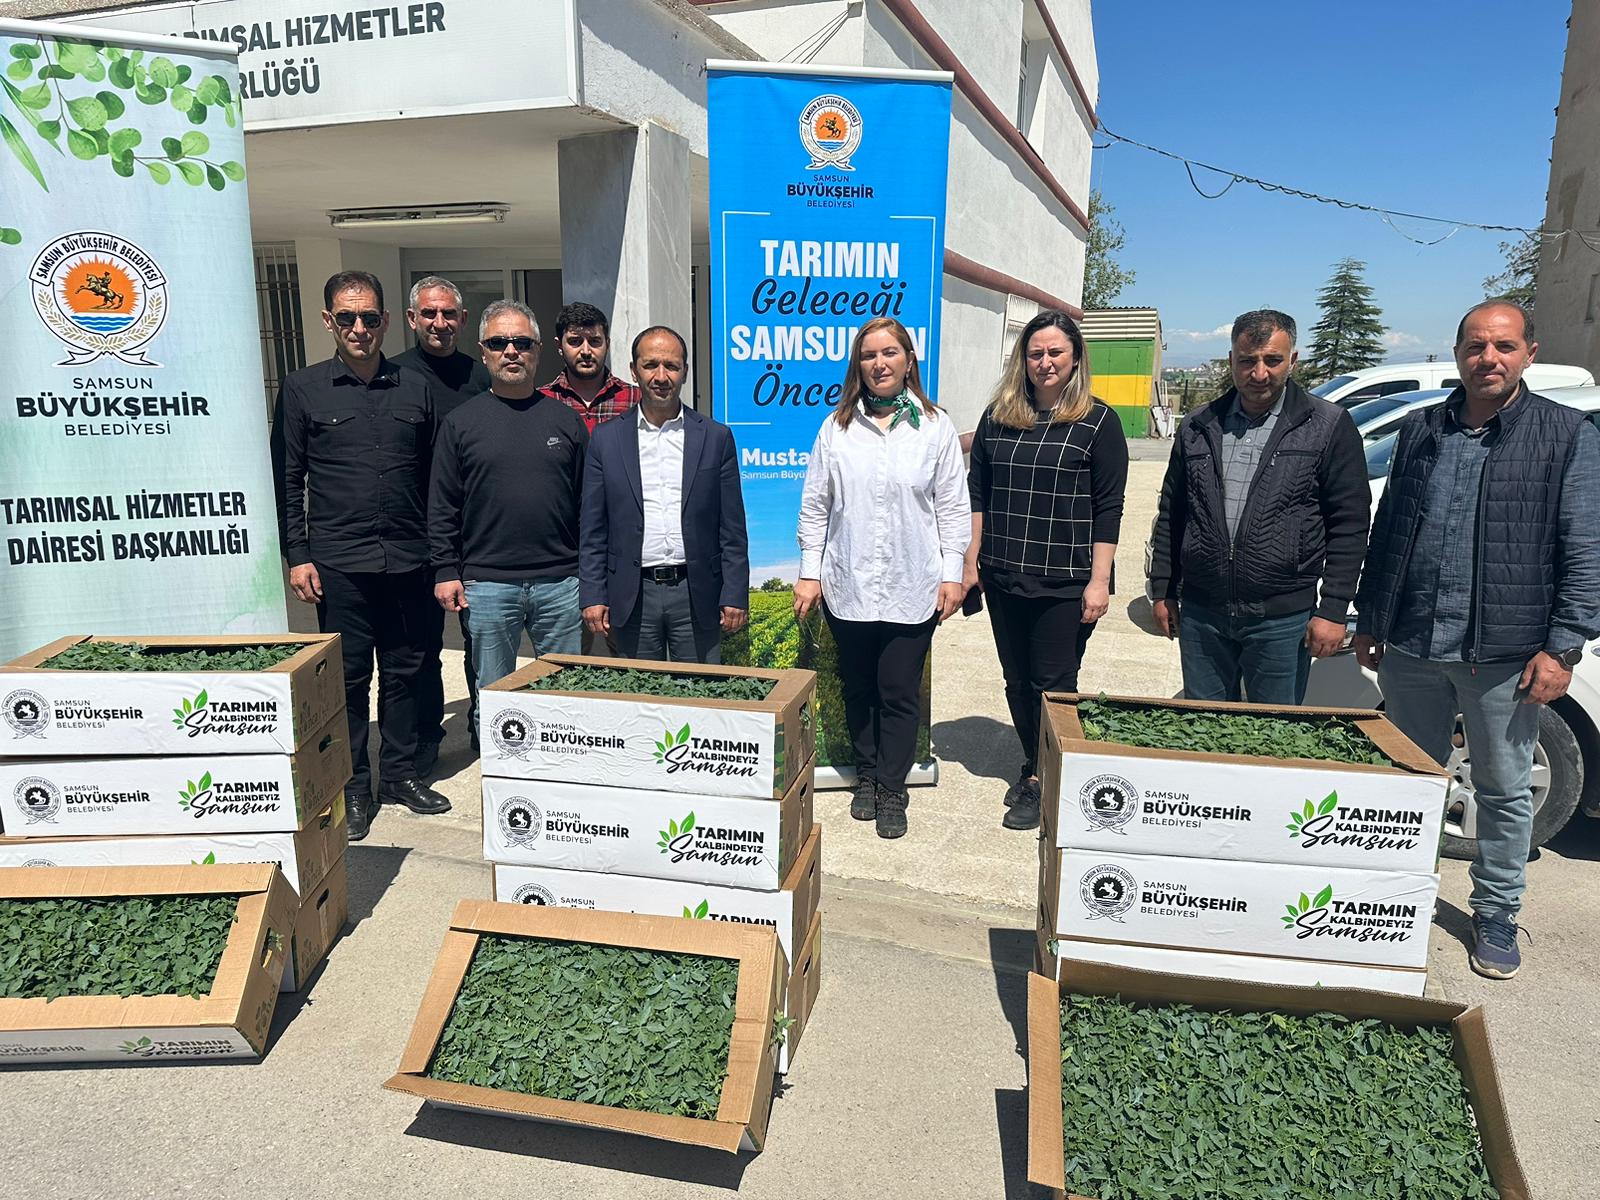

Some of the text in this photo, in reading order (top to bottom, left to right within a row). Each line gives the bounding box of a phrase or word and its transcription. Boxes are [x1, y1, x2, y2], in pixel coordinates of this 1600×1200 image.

[813, 174, 850, 182] SAMSUN
[787, 182, 874, 199] BÜYÜKŞEHİR
[807, 199, 855, 208] BELEDİYESİ
[36, 234, 162, 283] SAMSUN BÜYÜKŞEHİR BELEDİYESİ
[760, 239, 900, 278] TARIMIN
[751, 276, 907, 318] Geleceği
[72, 377, 153, 390] SAMSUN
[753, 363, 842, 407] Önce
[15, 391, 211, 420] BÜYÜKŞEHİR
[64, 419, 172, 436] BELEDİYESİ
[741, 447, 811, 466] Musta
[741, 470, 779, 480] Samsun
[2, 488, 248, 525] TARIMSAL HİZMETLER
[7, 523, 250, 566] DAİRESİ BAŞKANLIĞI
[55, 706, 144, 721] BÜYÜKŞEHİR
[209, 701, 277, 713] TARIMIN
[184, 709, 278, 738] Samsun
[540, 722, 576, 731] SAMSUN
[540, 730, 625, 749] BÜYÜKŞEHİR
[691, 737, 759, 755] TARIMIN
[665, 744, 758, 776] Samsun
[213, 781, 279, 793] TARIMIN
[1144, 790, 1190, 801] SAMSUN
[65, 790, 151, 805] BÜYÜKŞEHİR
[190, 790, 281, 819] Samsun
[546, 810, 581, 819] SAMSUN
[1143, 799, 1252, 821] BÜYÜKŞEHİR
[1337, 806, 1423, 825] TARIMIN
[546, 818, 630, 838] BÜYÜKŞEHİR
[1142, 816, 1202, 828] BELEDİYESİ
[546, 833, 592, 844] BELEDİYESİ
[695, 826, 764, 844] TARIMIN
[1300, 814, 1418, 851] Samsun
[669, 833, 763, 866] Samsun
[1143, 880, 1187, 892] SAMSUN
[560, 896, 595, 906] SAMSUN
[1141, 890, 1248, 913] BÜYÜKŞEHİR
[1332, 900, 1417, 918] TARIMIN
[1140, 906, 1199, 918] BELEDİYESİ
[1295, 908, 1411, 943] Samsun
